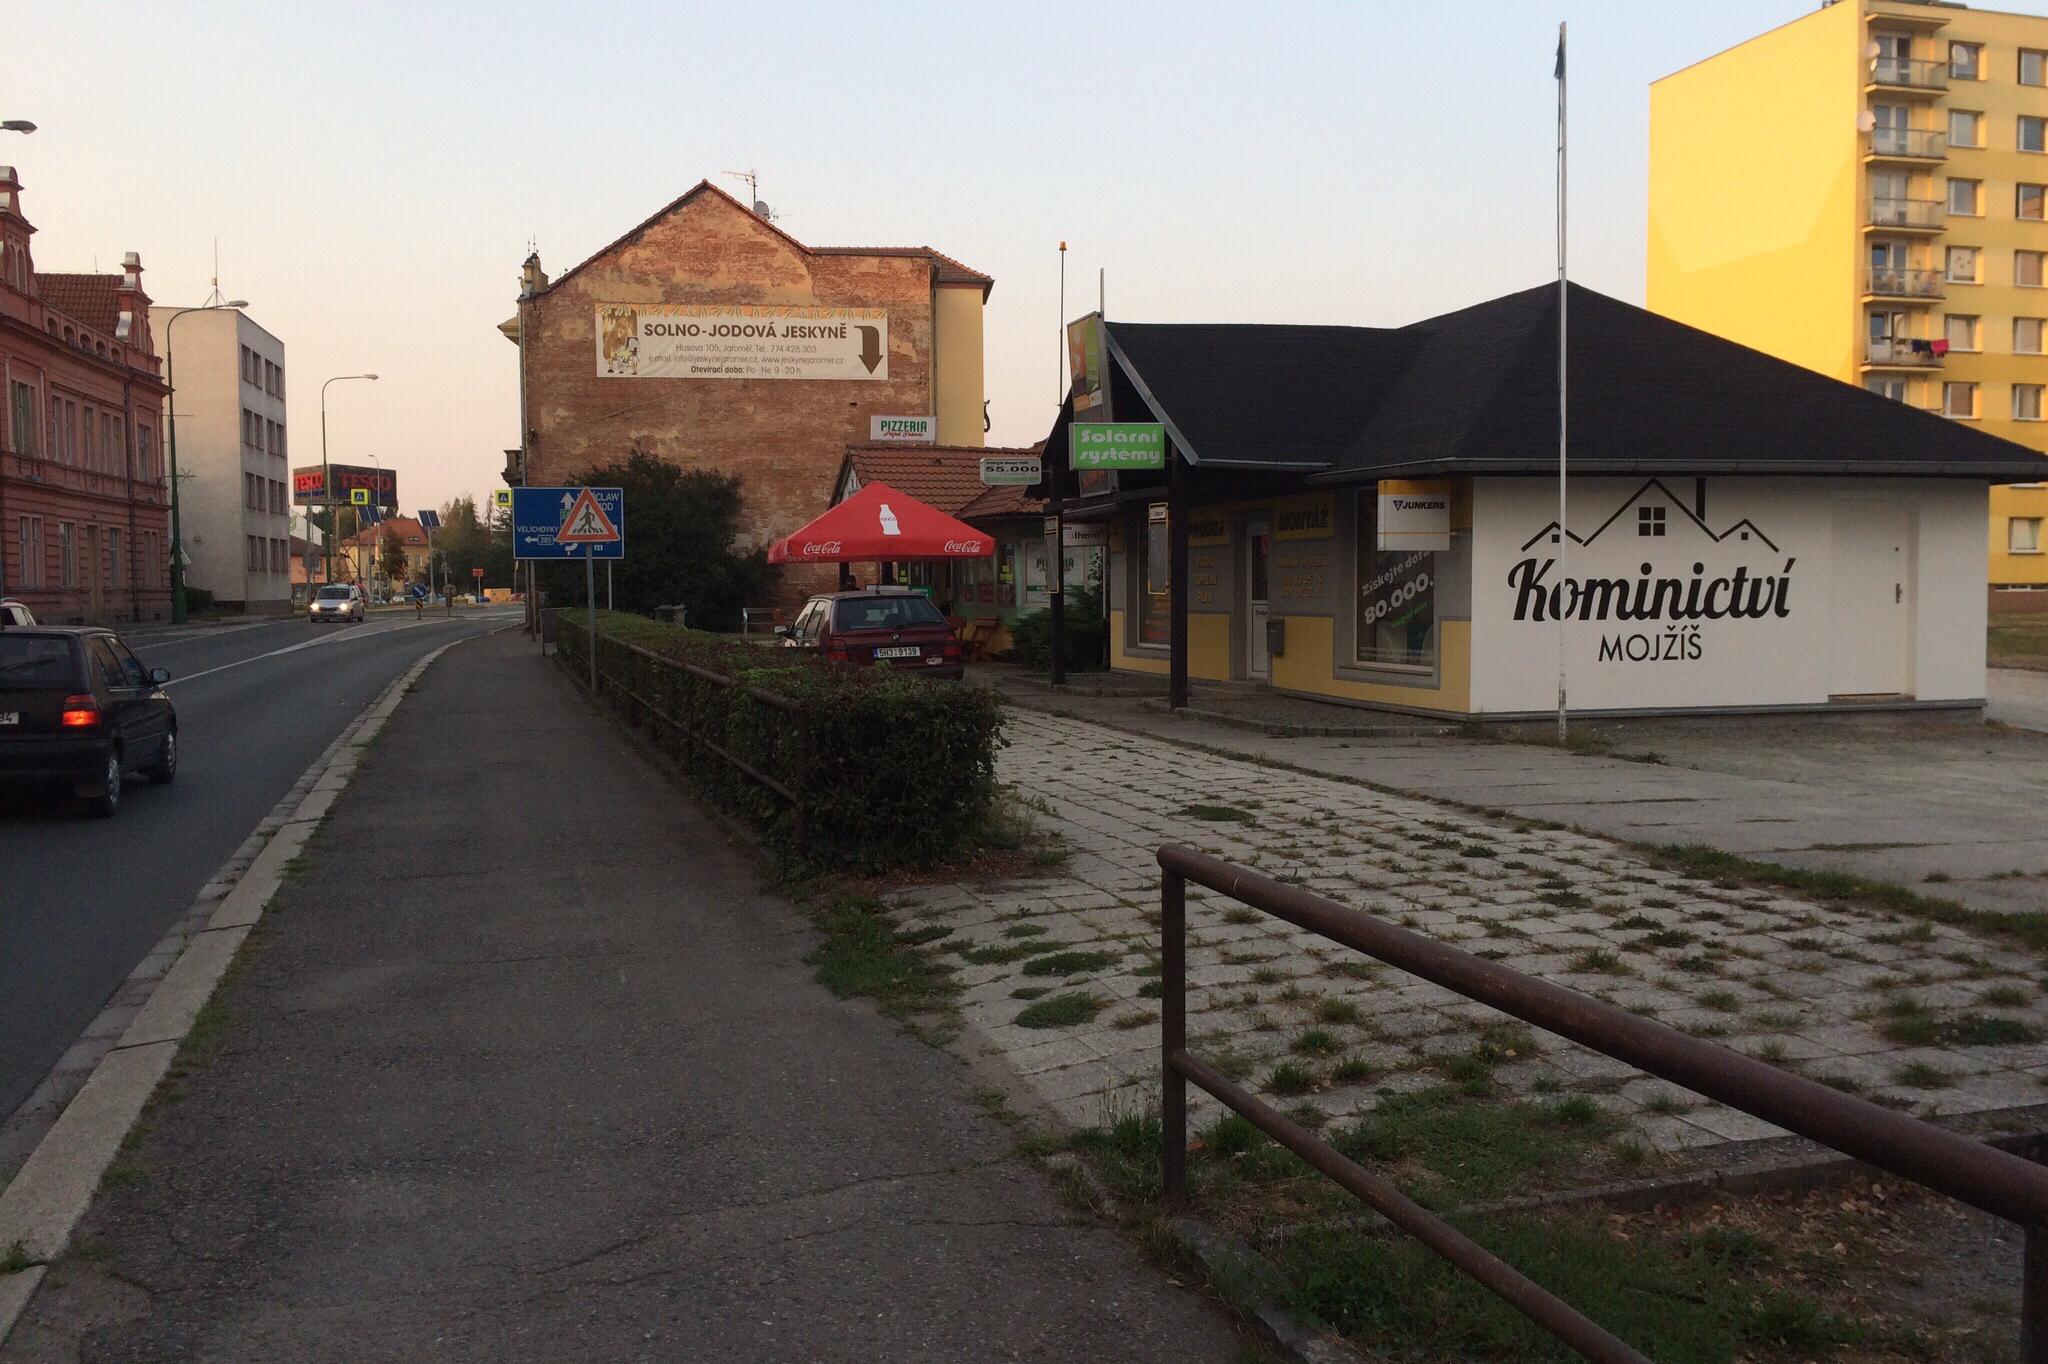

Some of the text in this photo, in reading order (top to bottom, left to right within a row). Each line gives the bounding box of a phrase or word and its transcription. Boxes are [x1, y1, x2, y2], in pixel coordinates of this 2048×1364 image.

[781, 322, 847, 339] JESKYNĚ
[675, 344, 704, 352] Husova
[770, 345, 784, 353] 774
[786, 345, 801, 353] 428
[802, 345, 817, 353] 303
[880, 420, 927, 433] PIZZERIA
[1081, 429, 1158, 443] Solární
[1080, 447, 1160, 464] systémy
[1402, 501, 1445, 510] JUNKERS
[516, 525, 559, 533] VELICHOVKY
[1507, 557, 1797, 622] Kominictví
[1598, 624, 1703, 662] MOJŽÍŠ
